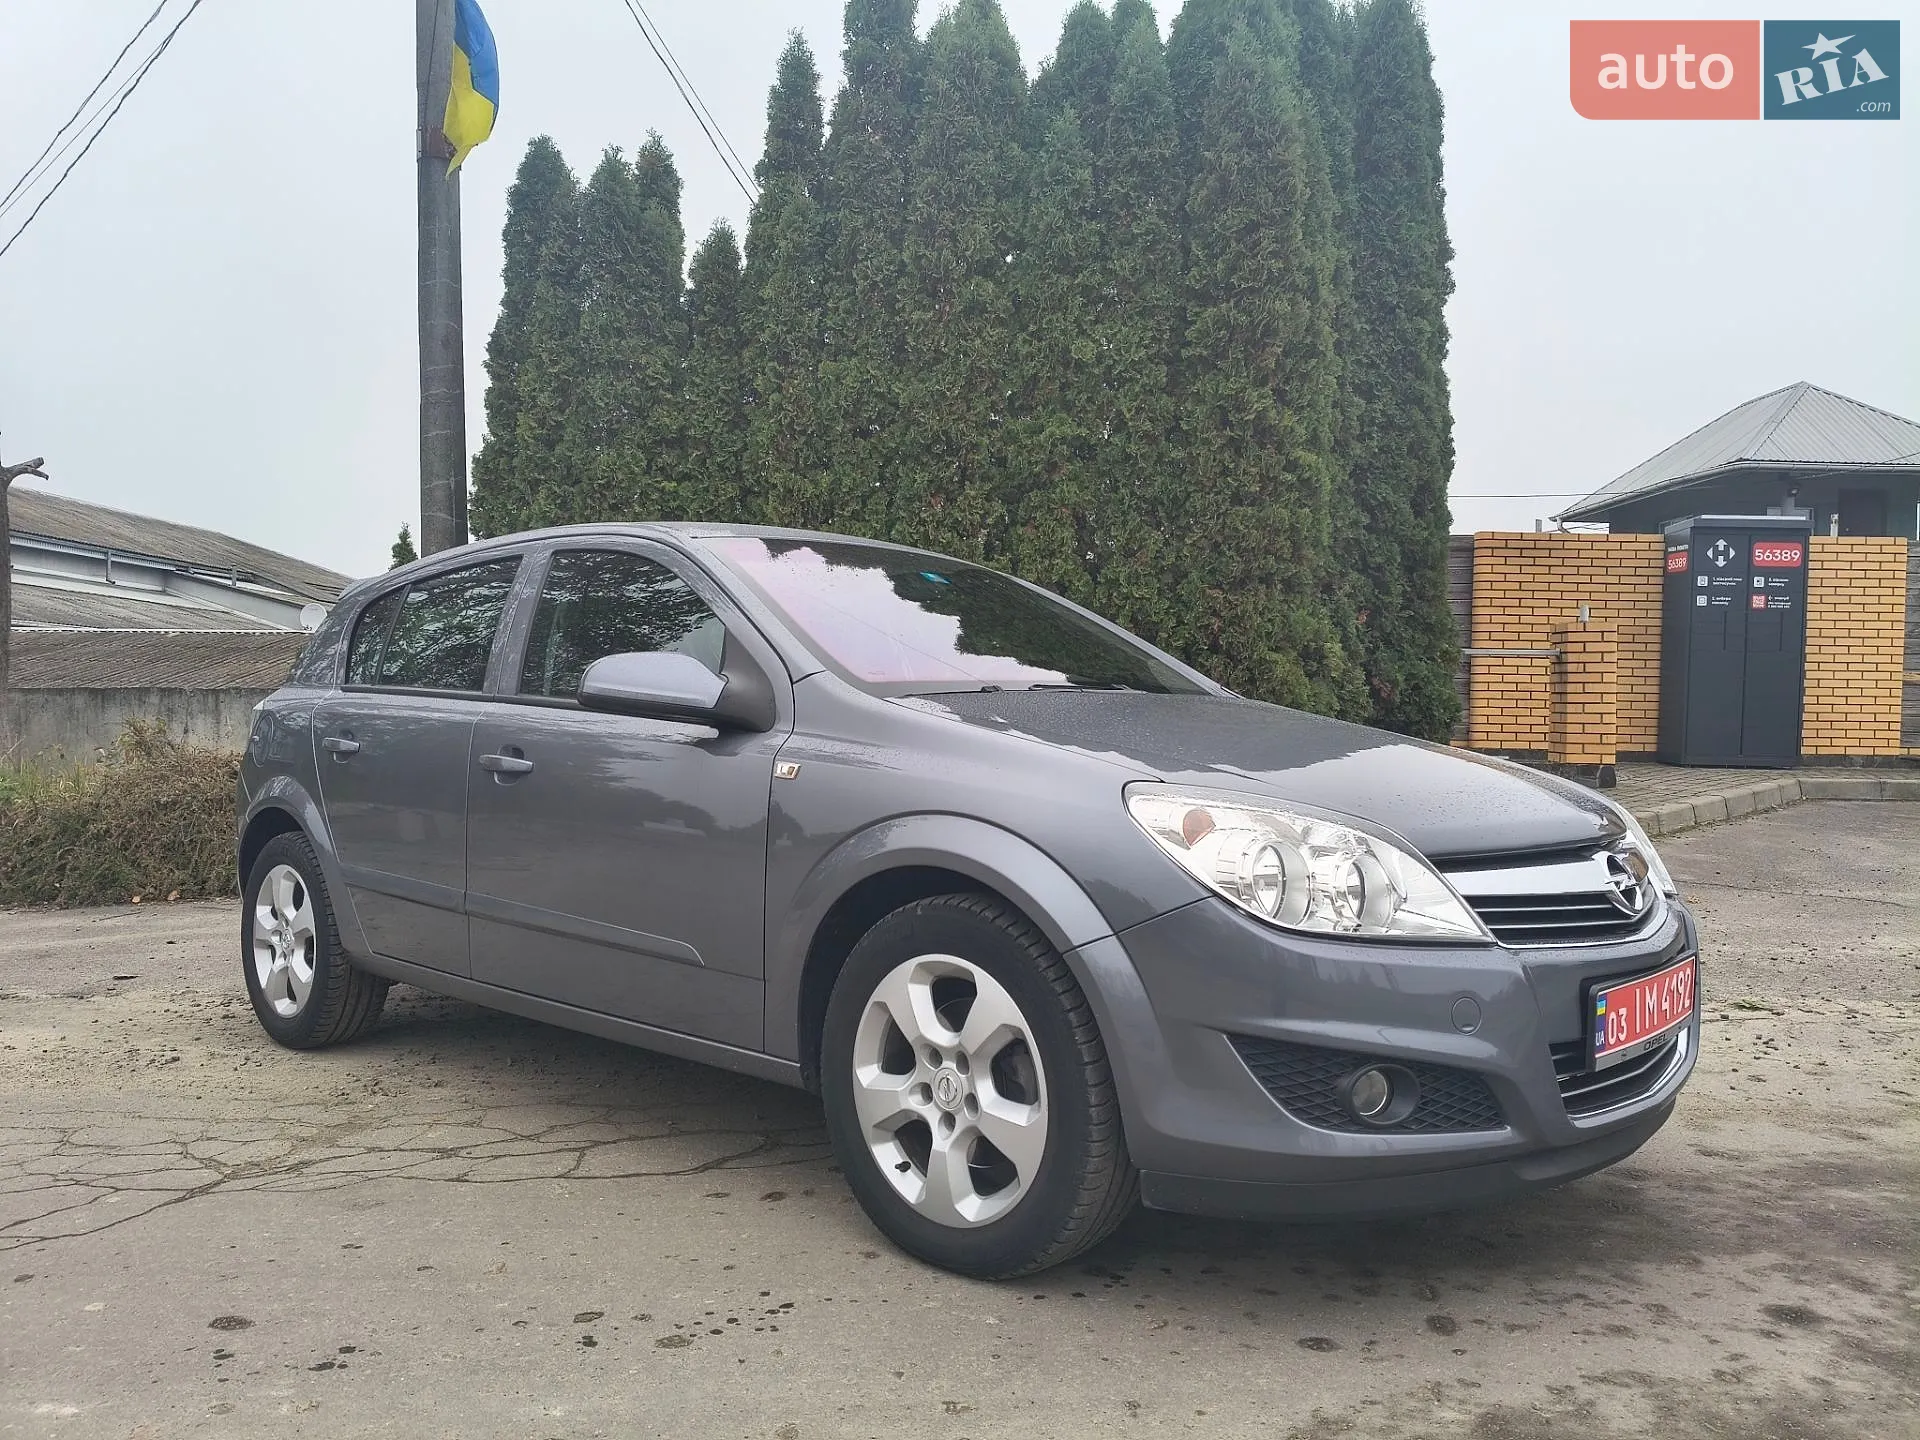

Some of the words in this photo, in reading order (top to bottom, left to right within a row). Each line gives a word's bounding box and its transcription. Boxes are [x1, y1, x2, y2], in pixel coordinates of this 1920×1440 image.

[1754, 549, 1801, 562] 56389
[1608, 1007, 1628, 1046] 03
[1595, 1030, 1605, 1047] UA
